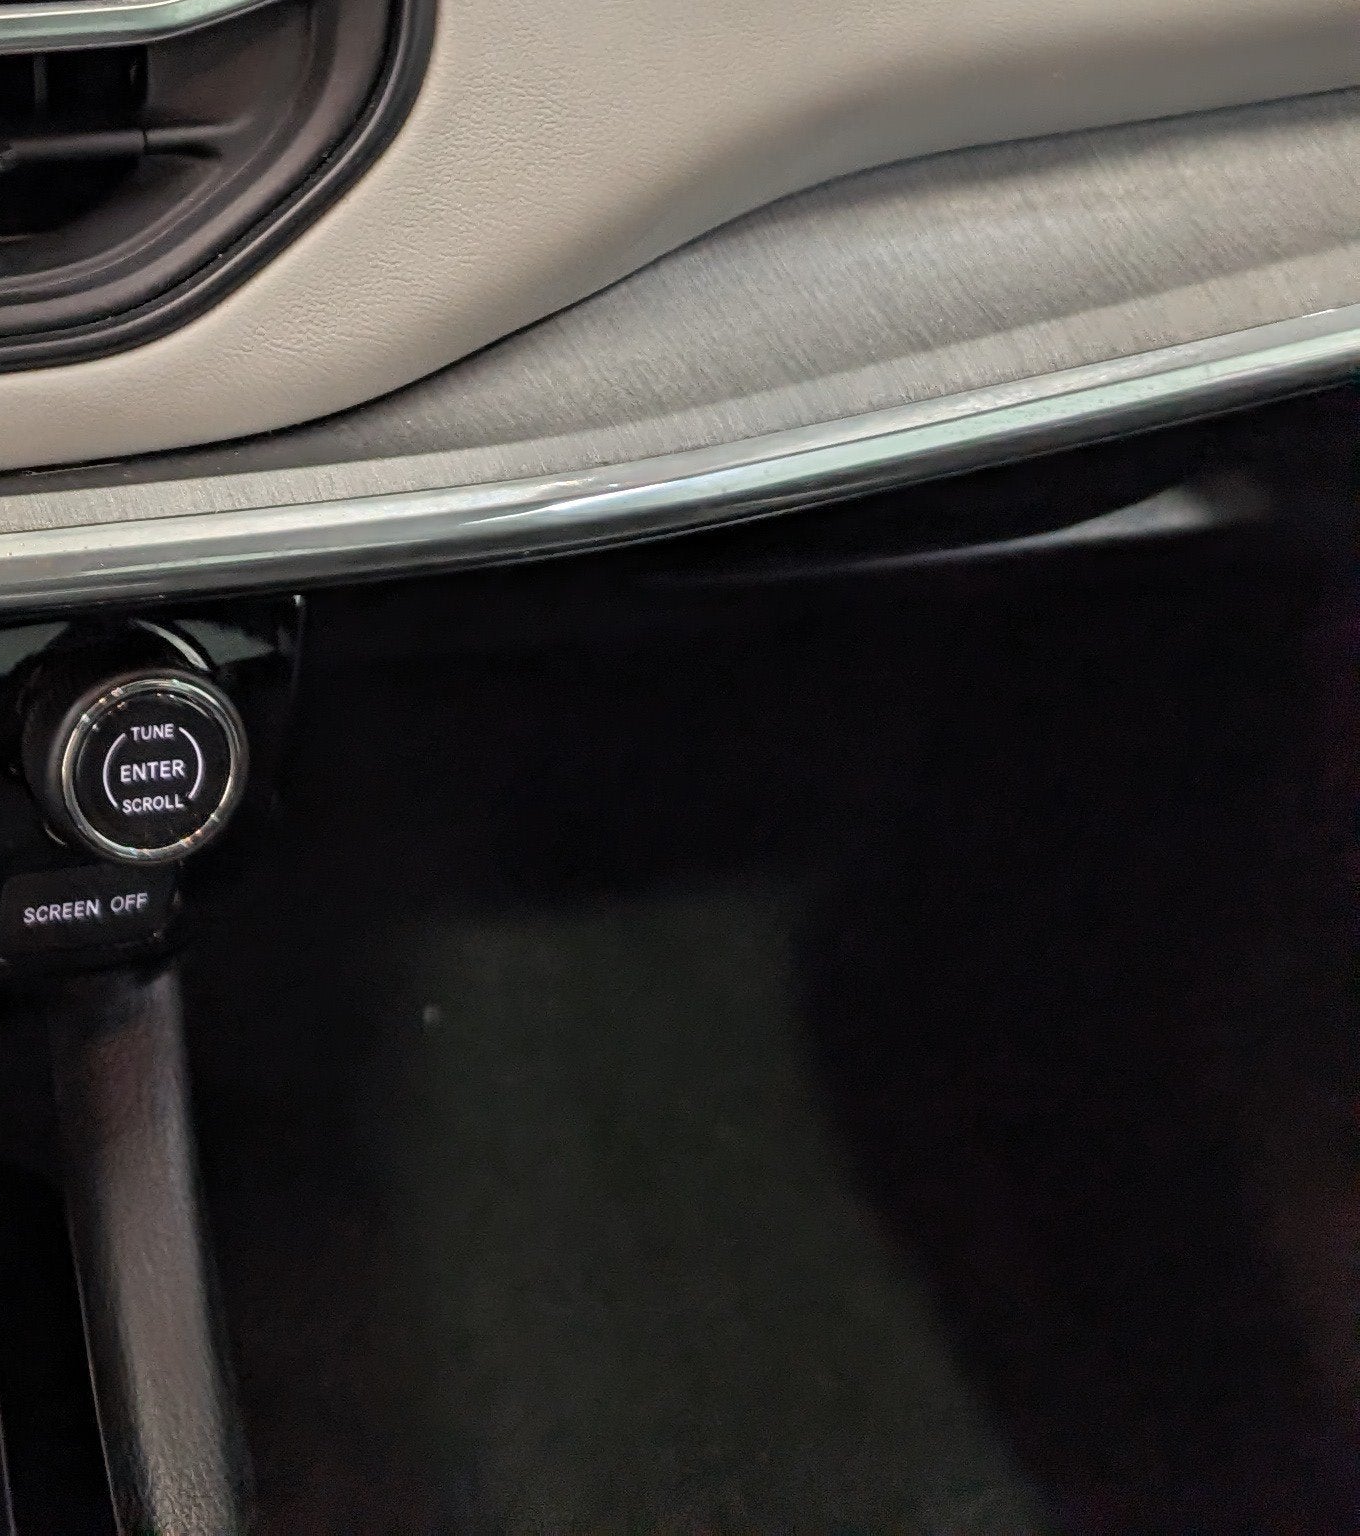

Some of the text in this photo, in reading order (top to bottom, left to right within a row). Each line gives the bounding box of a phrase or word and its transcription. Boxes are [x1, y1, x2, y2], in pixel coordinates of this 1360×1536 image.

[131, 724, 174, 740] TUNE
[121, 760, 184, 782] ENTER
[123, 794, 184, 813] SCROLL
[24, 893, 147, 923] SCREEN OFF
